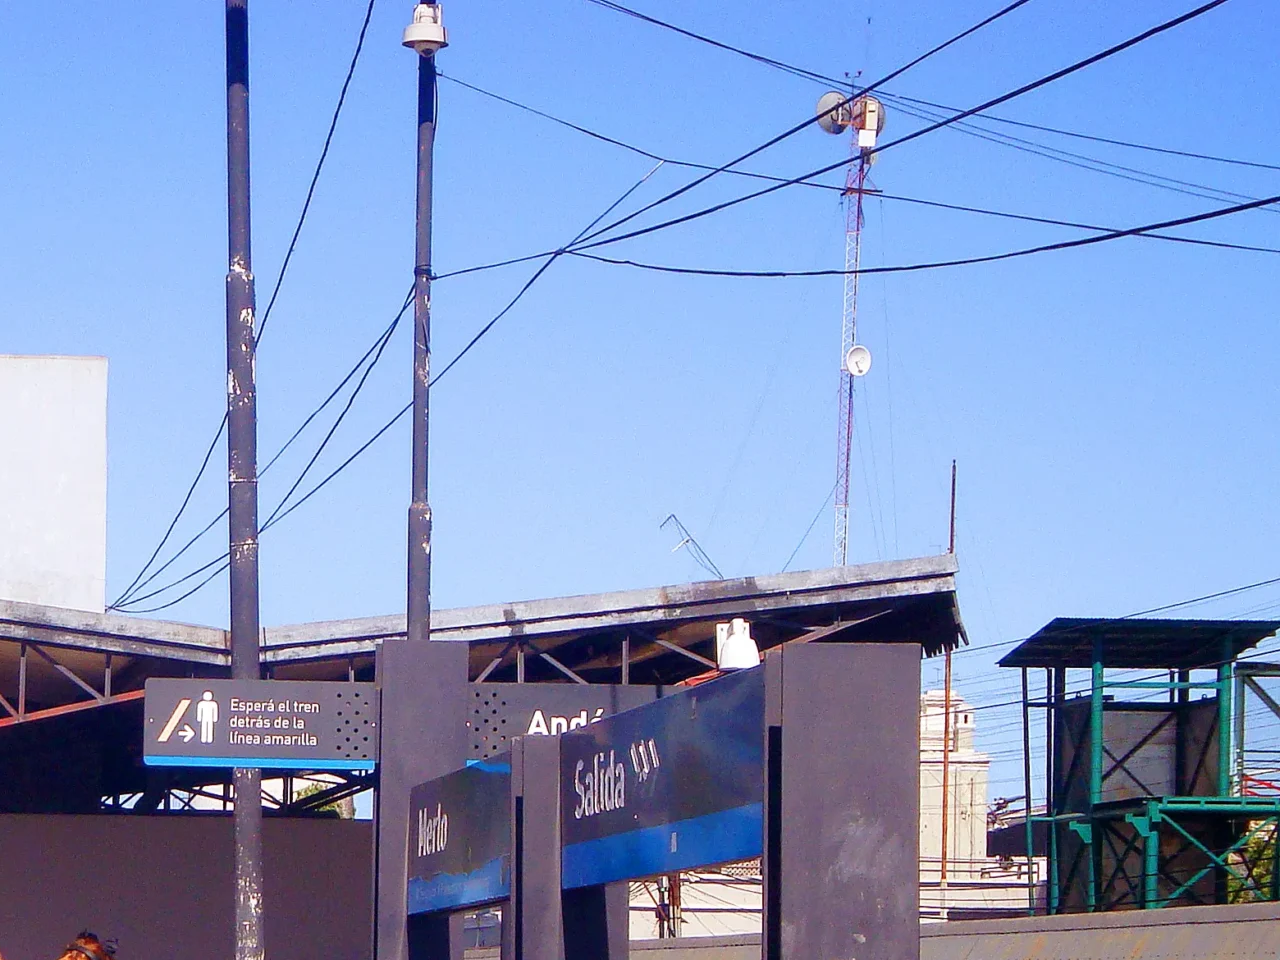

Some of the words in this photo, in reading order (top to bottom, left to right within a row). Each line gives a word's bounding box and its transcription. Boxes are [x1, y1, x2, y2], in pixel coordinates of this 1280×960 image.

[230, 698, 275, 714] Esperá
[278, 700, 290, 713] el
[293, 701, 320, 713] tren
[229, 715, 271, 729] detrás
[274, 716, 290, 729] de
[293, 717, 305, 729] la
[229, 731, 261, 745] línea
[264, 733, 318, 746] amarilla
[574, 750, 625, 819] Salida
[418, 803, 448, 858] Merlo
